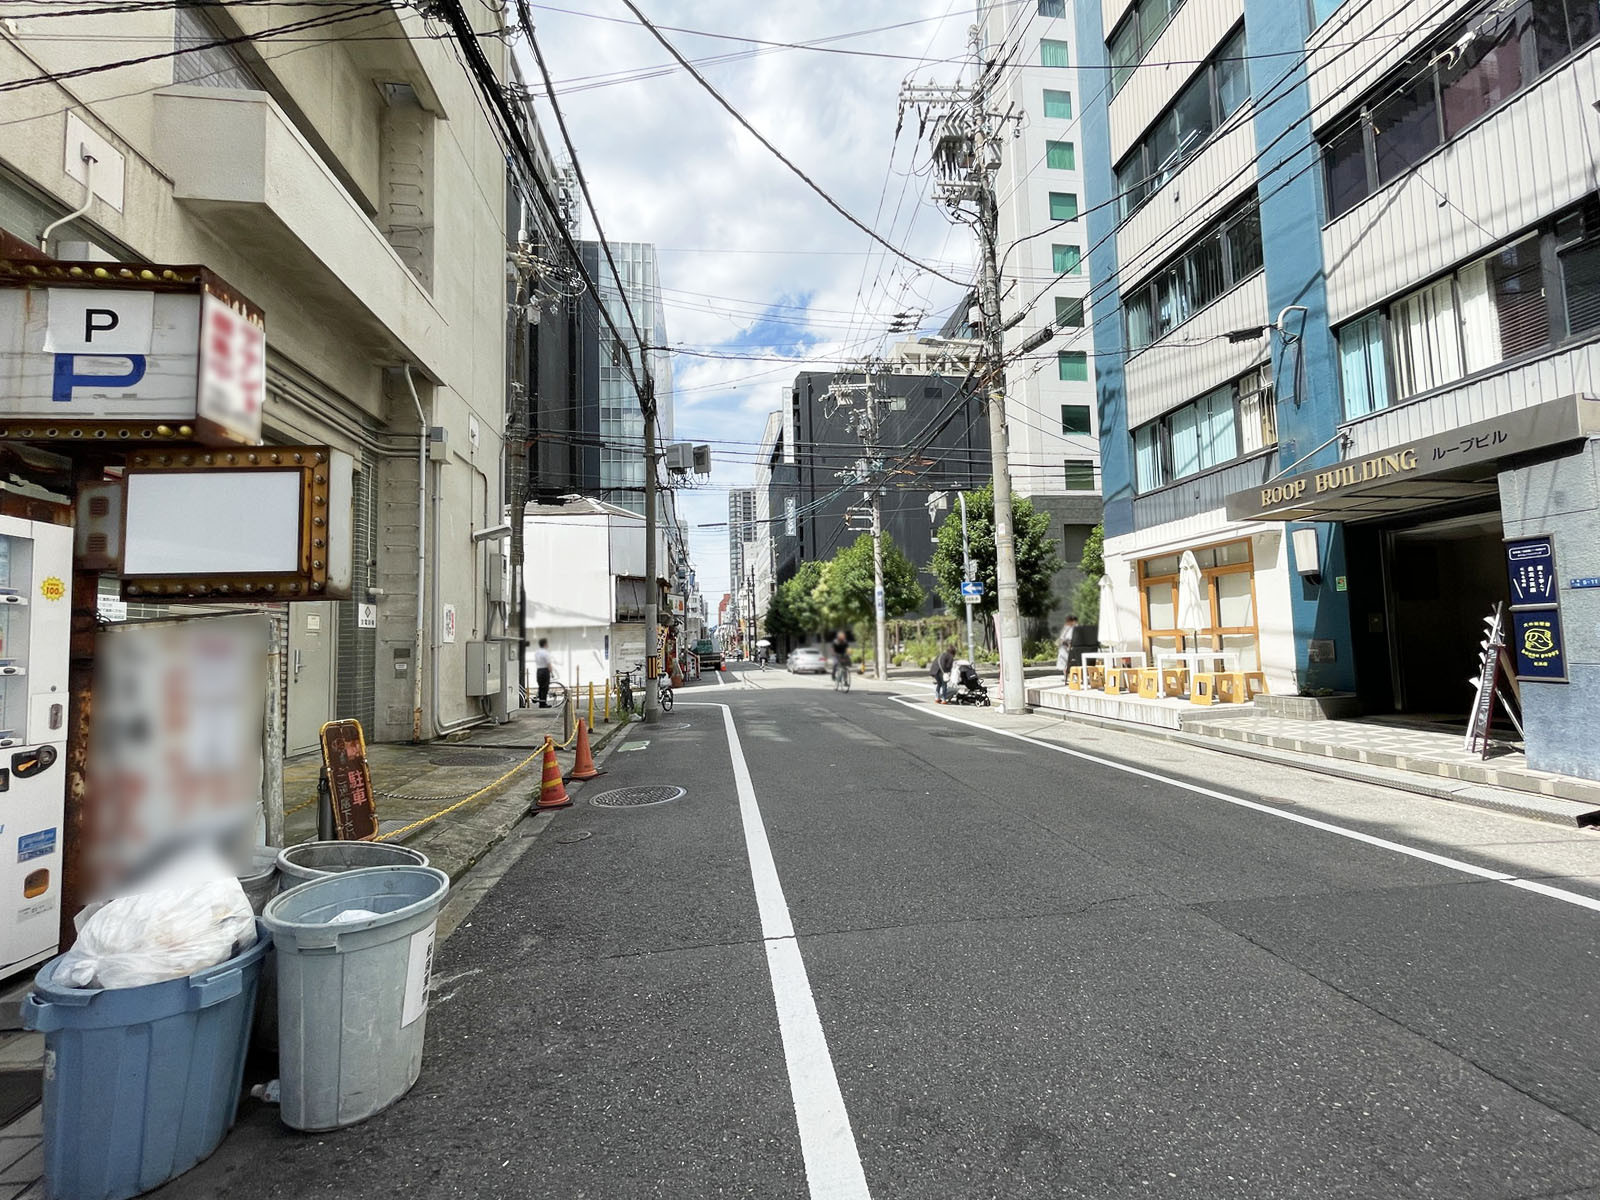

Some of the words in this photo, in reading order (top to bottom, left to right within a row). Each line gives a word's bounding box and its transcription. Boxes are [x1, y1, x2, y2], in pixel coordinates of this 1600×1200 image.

[85, 309, 119, 343] P
[52, 353, 147, 402] P
[1260, 479, 1307, 508] ROOP
[1315, 447, 1418, 494] BUILDING
